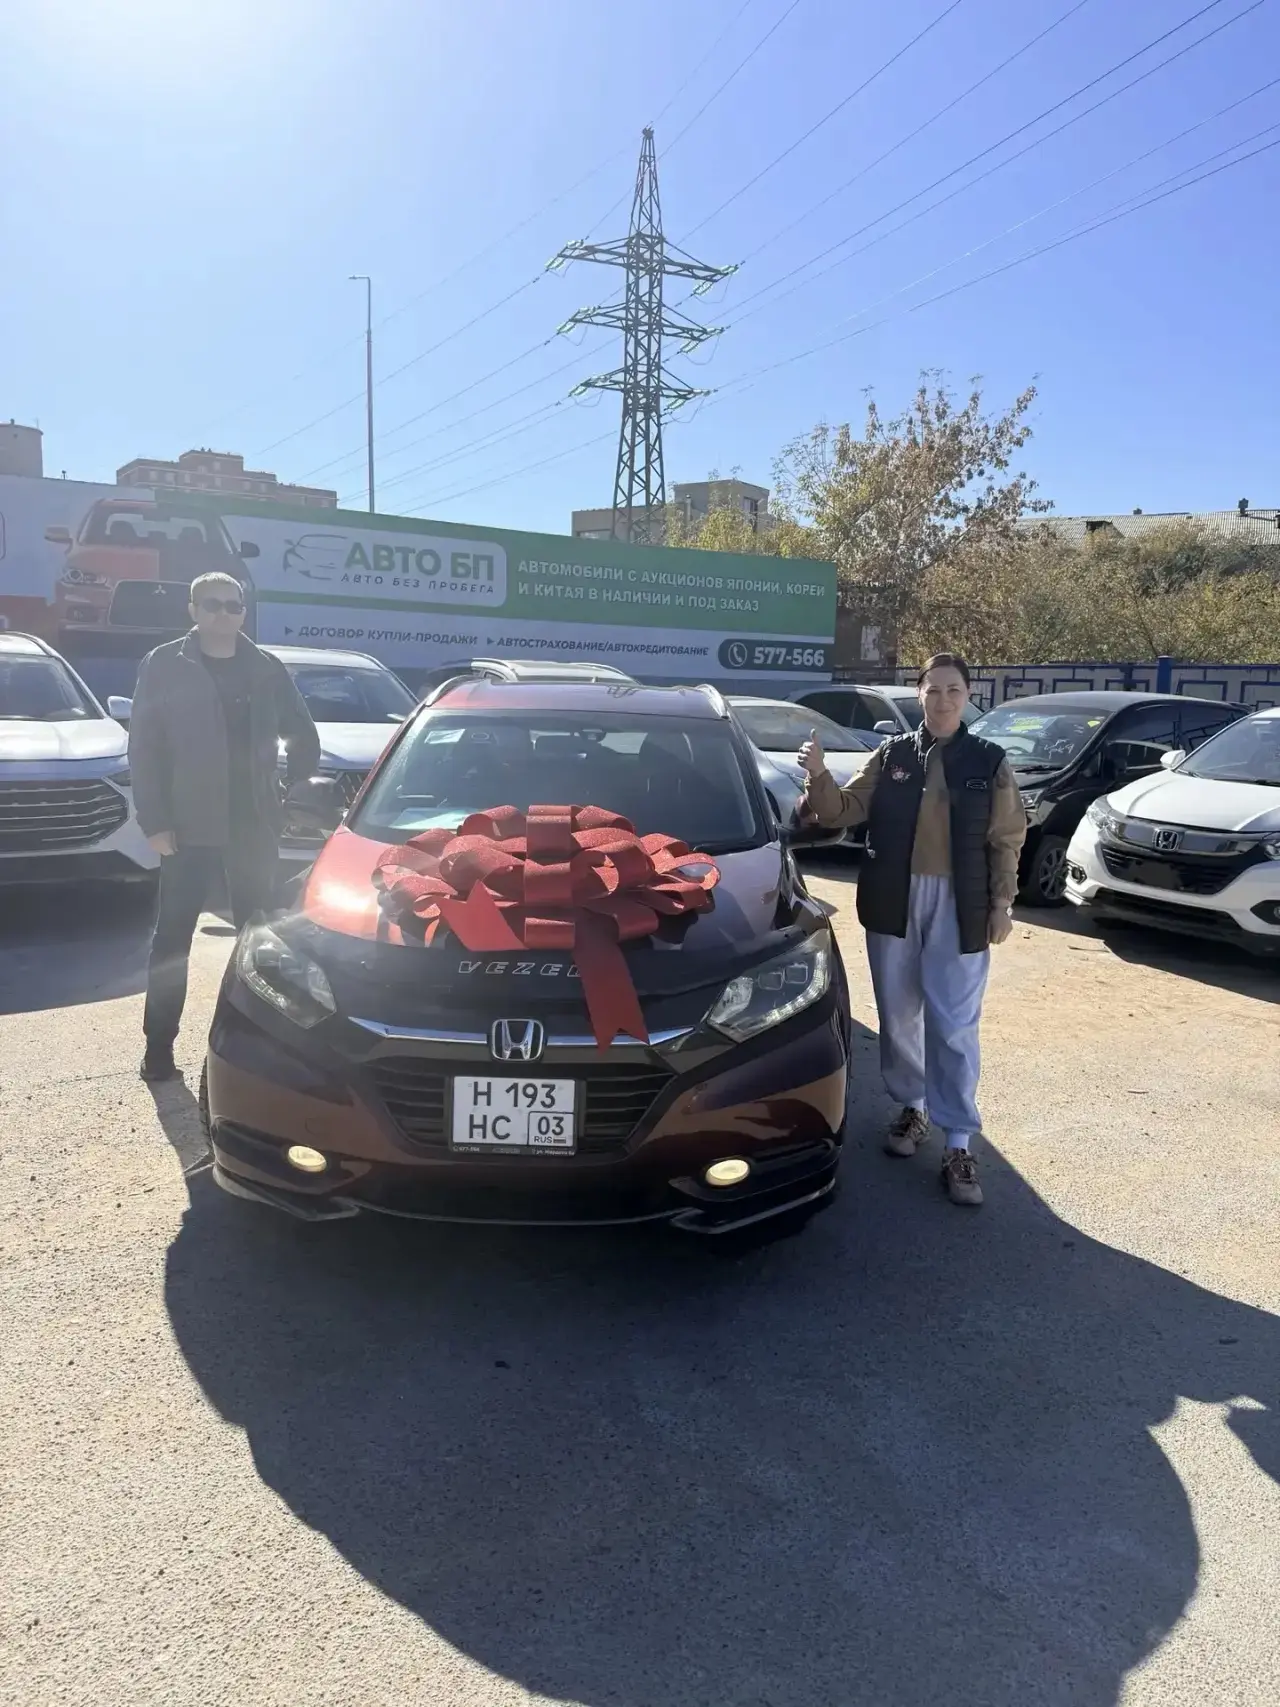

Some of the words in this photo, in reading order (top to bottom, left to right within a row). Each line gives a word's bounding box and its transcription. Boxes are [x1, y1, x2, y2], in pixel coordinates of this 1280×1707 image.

[344, 542, 442, 576] АВТО
[450, 552, 495, 581] БП
[341, 573, 384, 585] АВТО
[392, 577, 420, 588] БЕЗ
[428, 580, 494, 594] ПРОБЕГА
[517, 560, 623, 581] АВТОМОБИЛИ
[627, 570, 637, 582] С
[641, 571, 723, 589] АУКЦИОНОВ
[727, 578, 783, 595] ЯПОНИИ,
[518, 582, 529, 595] И
[534, 583, 584, 600] КИТАЯ
[588, 588, 599, 600] В
[602, 588, 671, 606] НАЛИЧИИ
[675, 594, 684, 606] И
[688, 596, 717, 610] ПОД
[720, 599, 760, 612] ЗАКАЗ
[298, 626, 364, 639] ДОГОВОР
[367, 630, 478, 645] КУПЛИ-ПРОДАЖИ
[496, 637, 709, 657] АВТОСТРАХОВАНИЕ/АВТОКРЕДИТОВАНИЕ
[753, 646, 825, 668] 577-566
[505, 1082, 556, 1108] 193
[537, 1116, 564, 1136] 03
[534, 1135, 552, 1144] RUS
